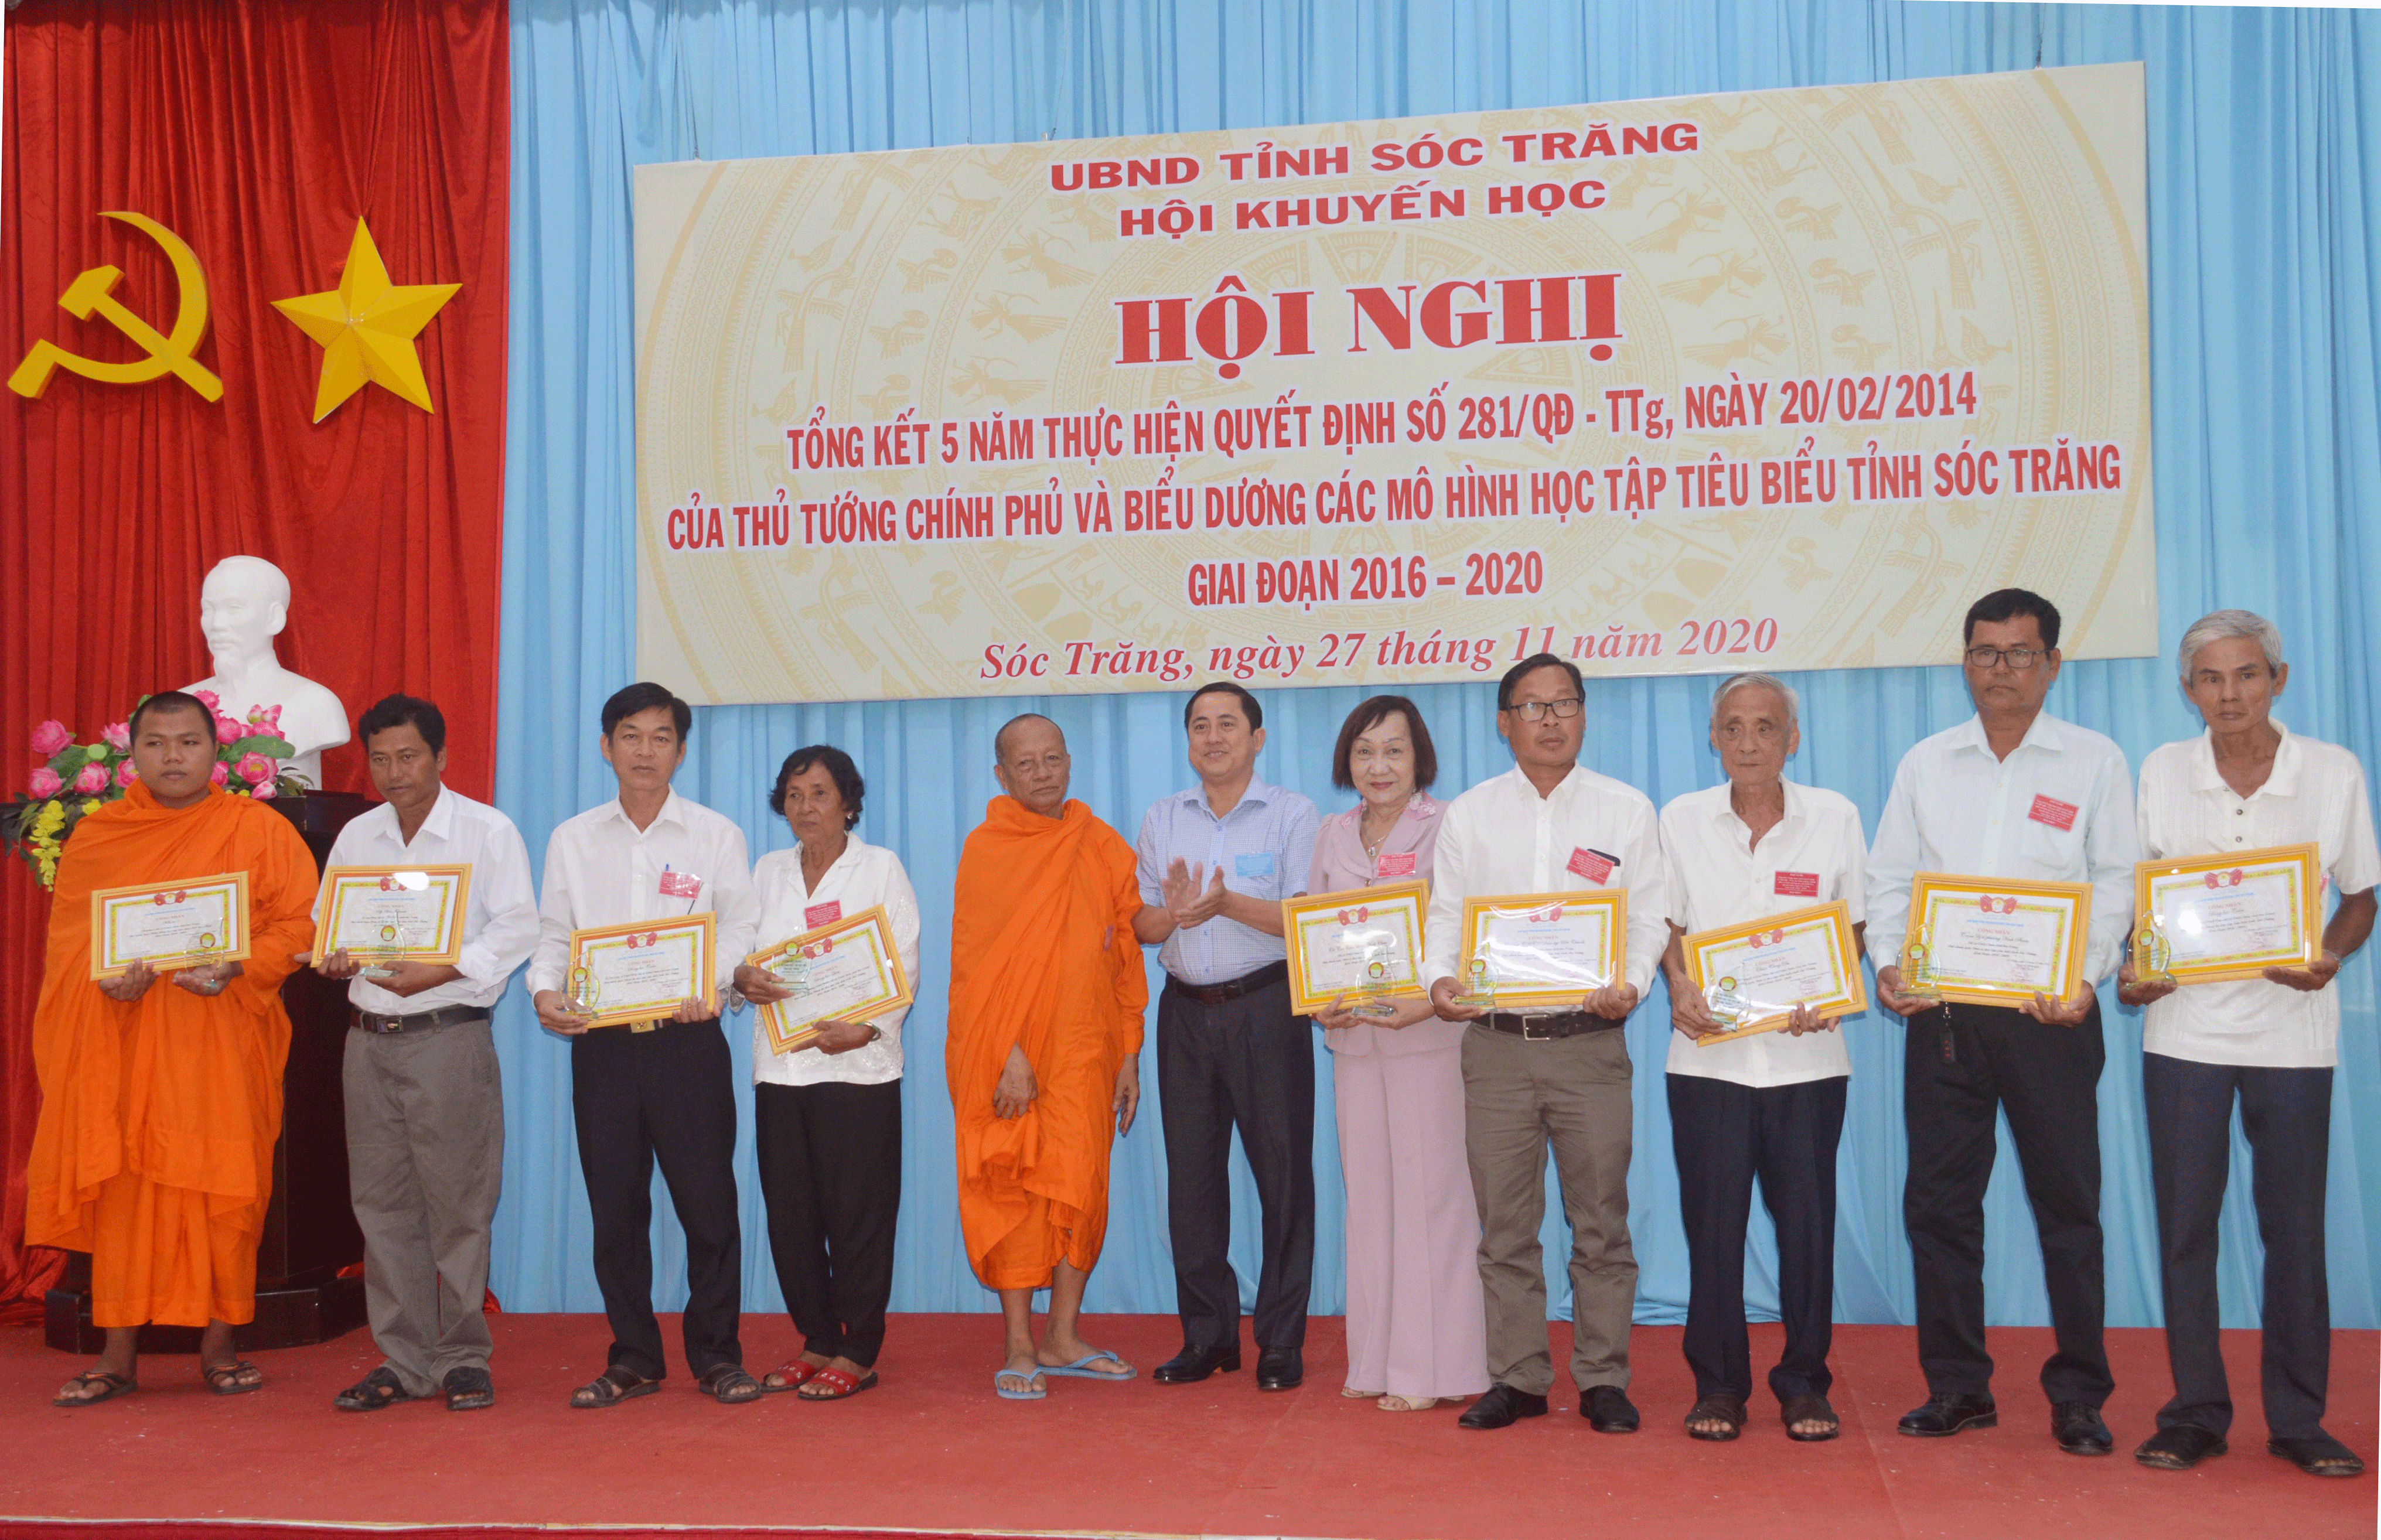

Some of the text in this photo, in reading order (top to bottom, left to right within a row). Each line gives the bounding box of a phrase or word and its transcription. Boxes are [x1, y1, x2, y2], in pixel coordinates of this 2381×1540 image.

[1052, 124, 1697, 190] UBND TỈNH SÓC TRĂNG
[1121, 180, 1605, 239] HỘI KHUYẾN HỌC
[1115, 274, 1622, 379] HỘI NGHỊ
[787, 407, 863, 469] TỔNG
[875, 408, 930, 465] KẾT
[942, 423, 958, 463] 5
[970, 412, 1033, 461] NĂM
[1043, 408, 1122, 465] THỰC
[1134, 401, 1203, 461] HIỆN
[1215, 389, 1311, 457] QUYẾT
[1323, 402, 1395, 455] ĐỊNH
[1407, 381, 1448, 442] SỐ
[1459, 394, 1574, 443] 281/QĐ
[1606, 390, 1673, 439] TTg,
[1686, 373, 1768, 428] NGÀY
[1781, 372, 1976, 424] 20/02/2014
[668, 435, 2120, 549] CỦA THỦ TƯỚNG CHÍNH PHỦ VÀ BIỂU DƯƠNG CÁC MÔ HÌNH HỌC TẬP TIÊU BIỂU TỈNH SÓC TRĂNG
[1189, 563, 1245, 606] GIAI
[1256, 559, 1338, 610] ĐOẠN
[1351, 556, 1427, 599] 2016
[1466, 551, 1543, 595] 2020
[981, 618, 1778, 681] Sóc Trăng, ngày 27 tháng 11 năm 2020
